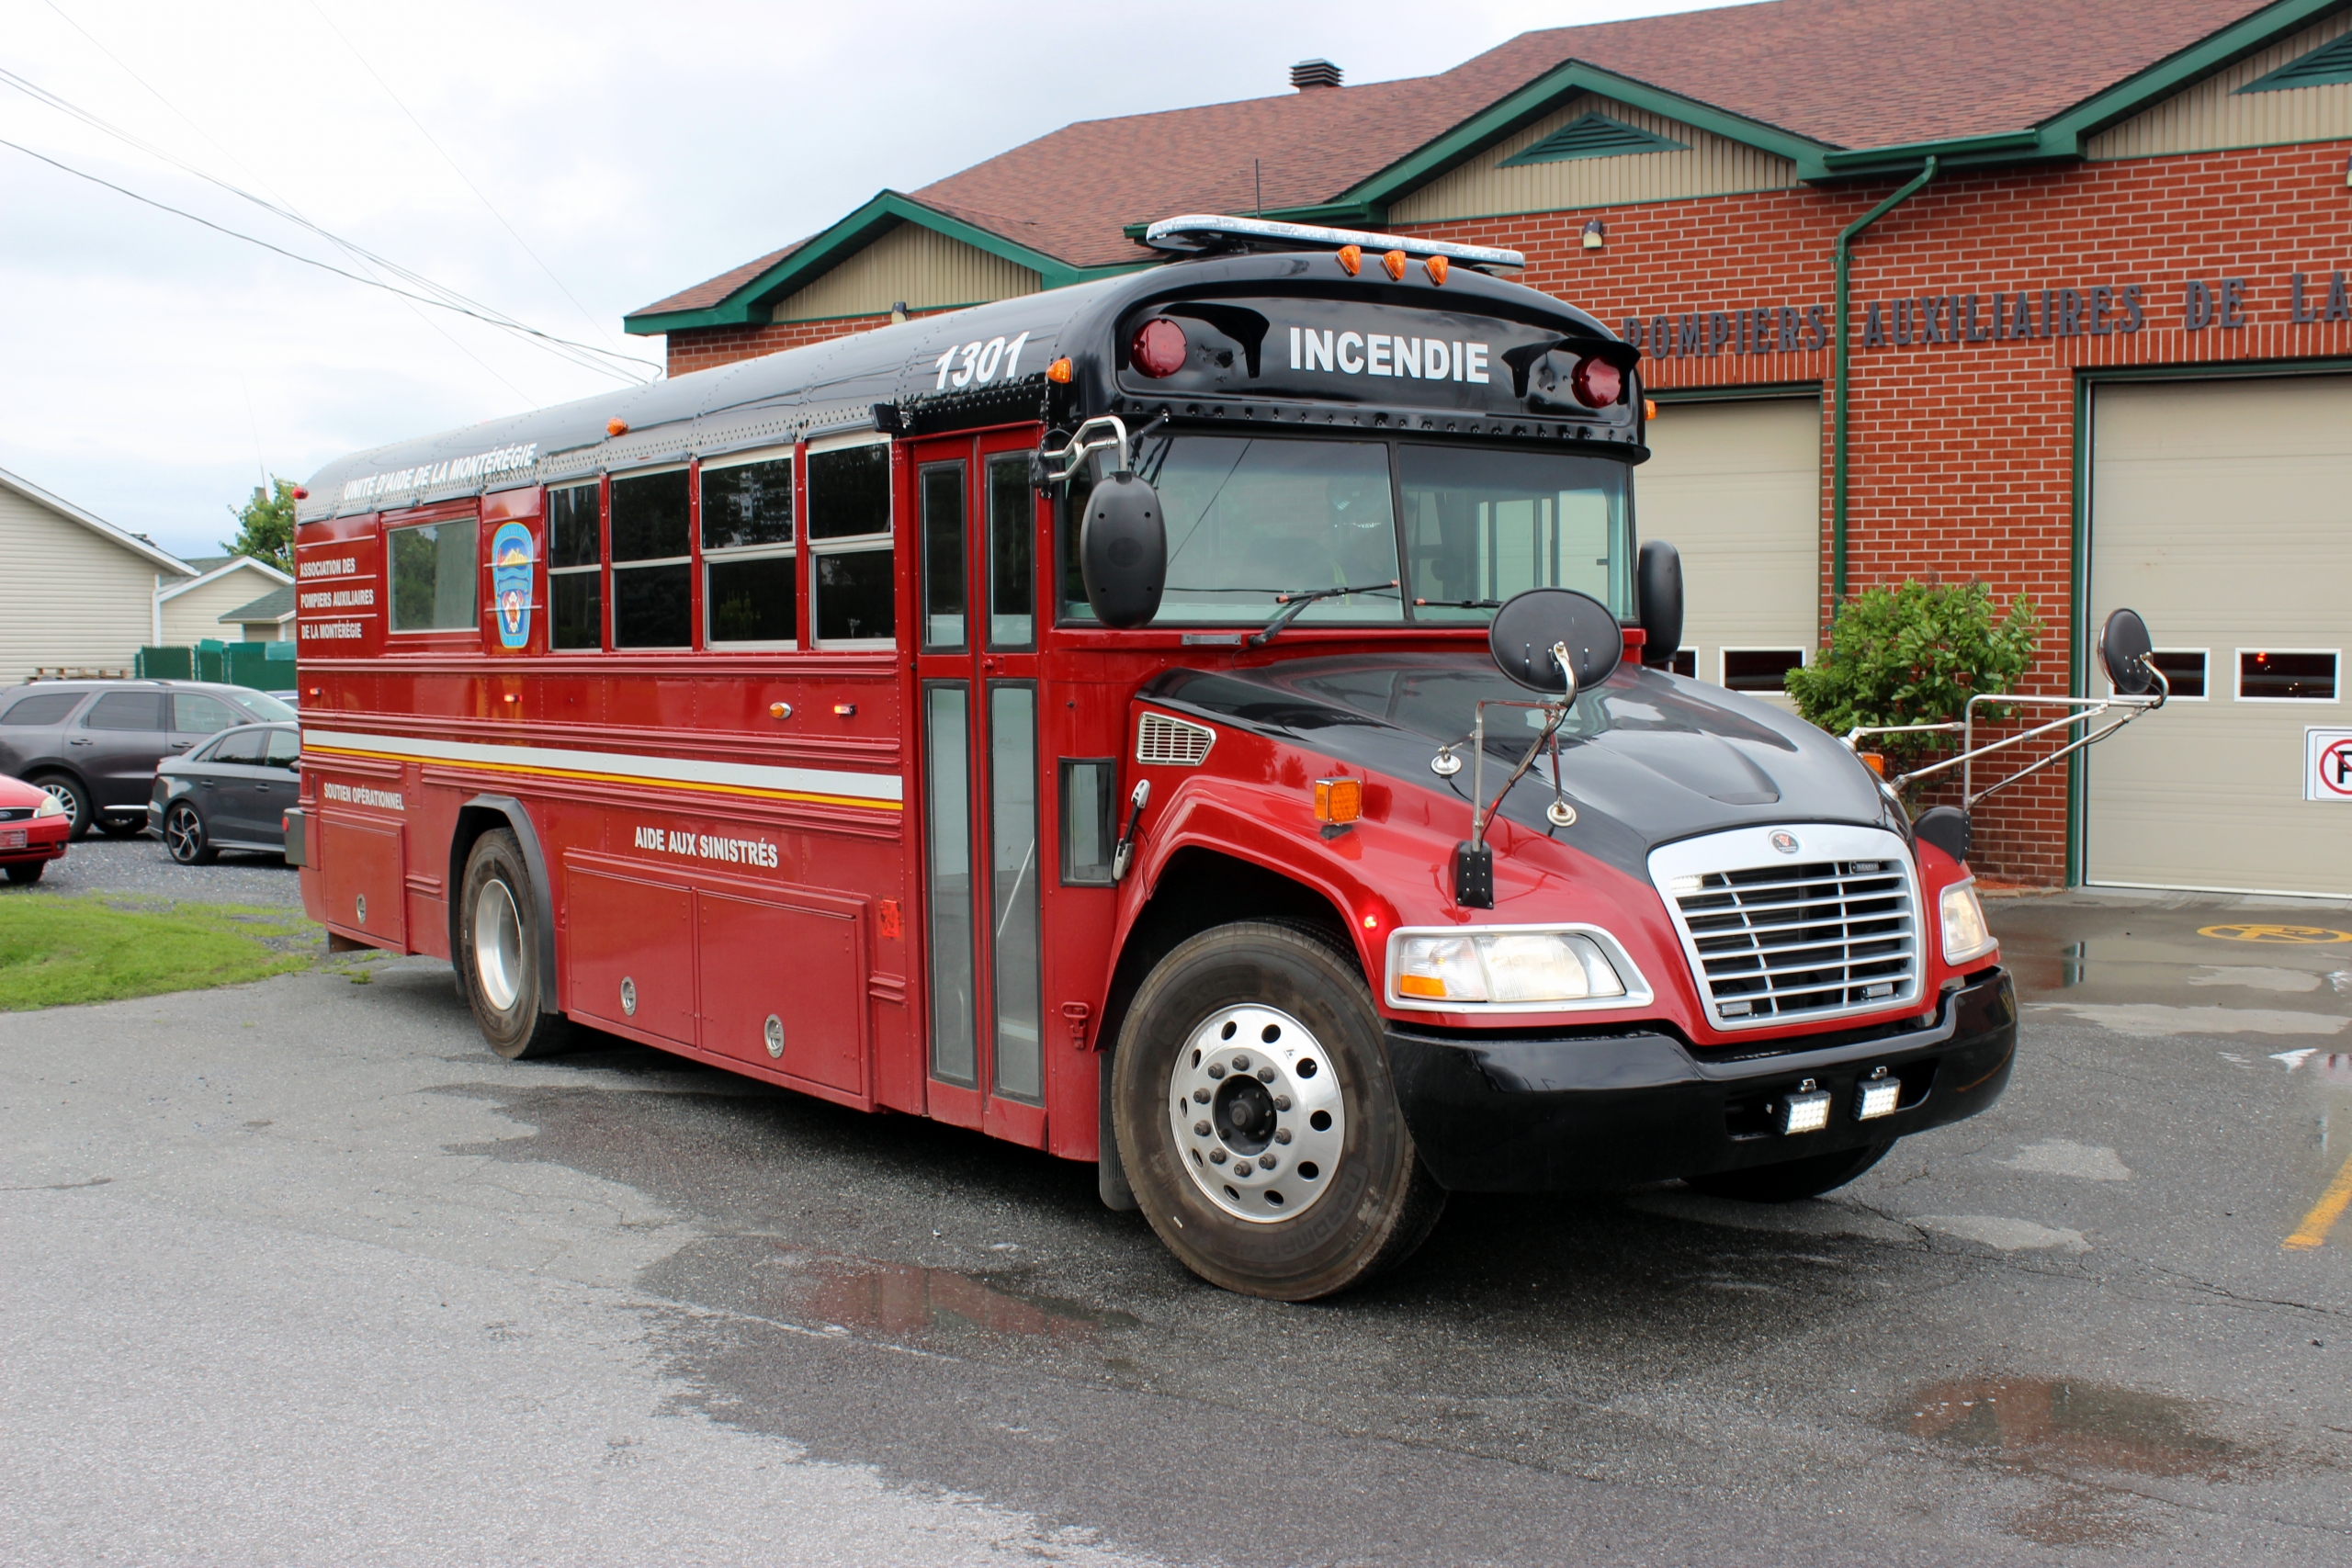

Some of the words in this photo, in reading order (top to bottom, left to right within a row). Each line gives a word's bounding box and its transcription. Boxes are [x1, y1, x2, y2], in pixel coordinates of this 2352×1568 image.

[1623, 305, 1826, 359] POMPIERS
[1862, 285, 2143, 347] AUXILIAIRES
[2187, 277, 2245, 331] DE
[2291, 271, 2351, 323] LA
[935, 331, 1030, 390] 1301
[1290, 327, 1489, 384] INCENDIE
[345, 471, 379, 501] UNITÉ
[376, 468, 414, 494] D'AIDE
[413, 464, 433, 488] DE
[430, 461, 448, 484] LA
[449, 443, 537, 480] MONTÉRÉGIE
[300, 558, 342, 578] ASSOCIATION
[342, 557, 356, 574] DES
[300, 592, 332, 608] POMPIERS
[333, 589, 374, 606] AUXILIAIRES
[301, 624, 310, 639] DE
[311, 624, 319, 639] LA
[320, 619, 362, 639] MONTÉRÉGIE
[323, 782, 351, 802] SOUTIEN
[352, 784, 405, 810] OPÉRATIONNEL
[635, 826, 665, 852] AIDE
[668, 830, 696, 856] AUX
[699, 837, 778, 868] SINISTRÉS
